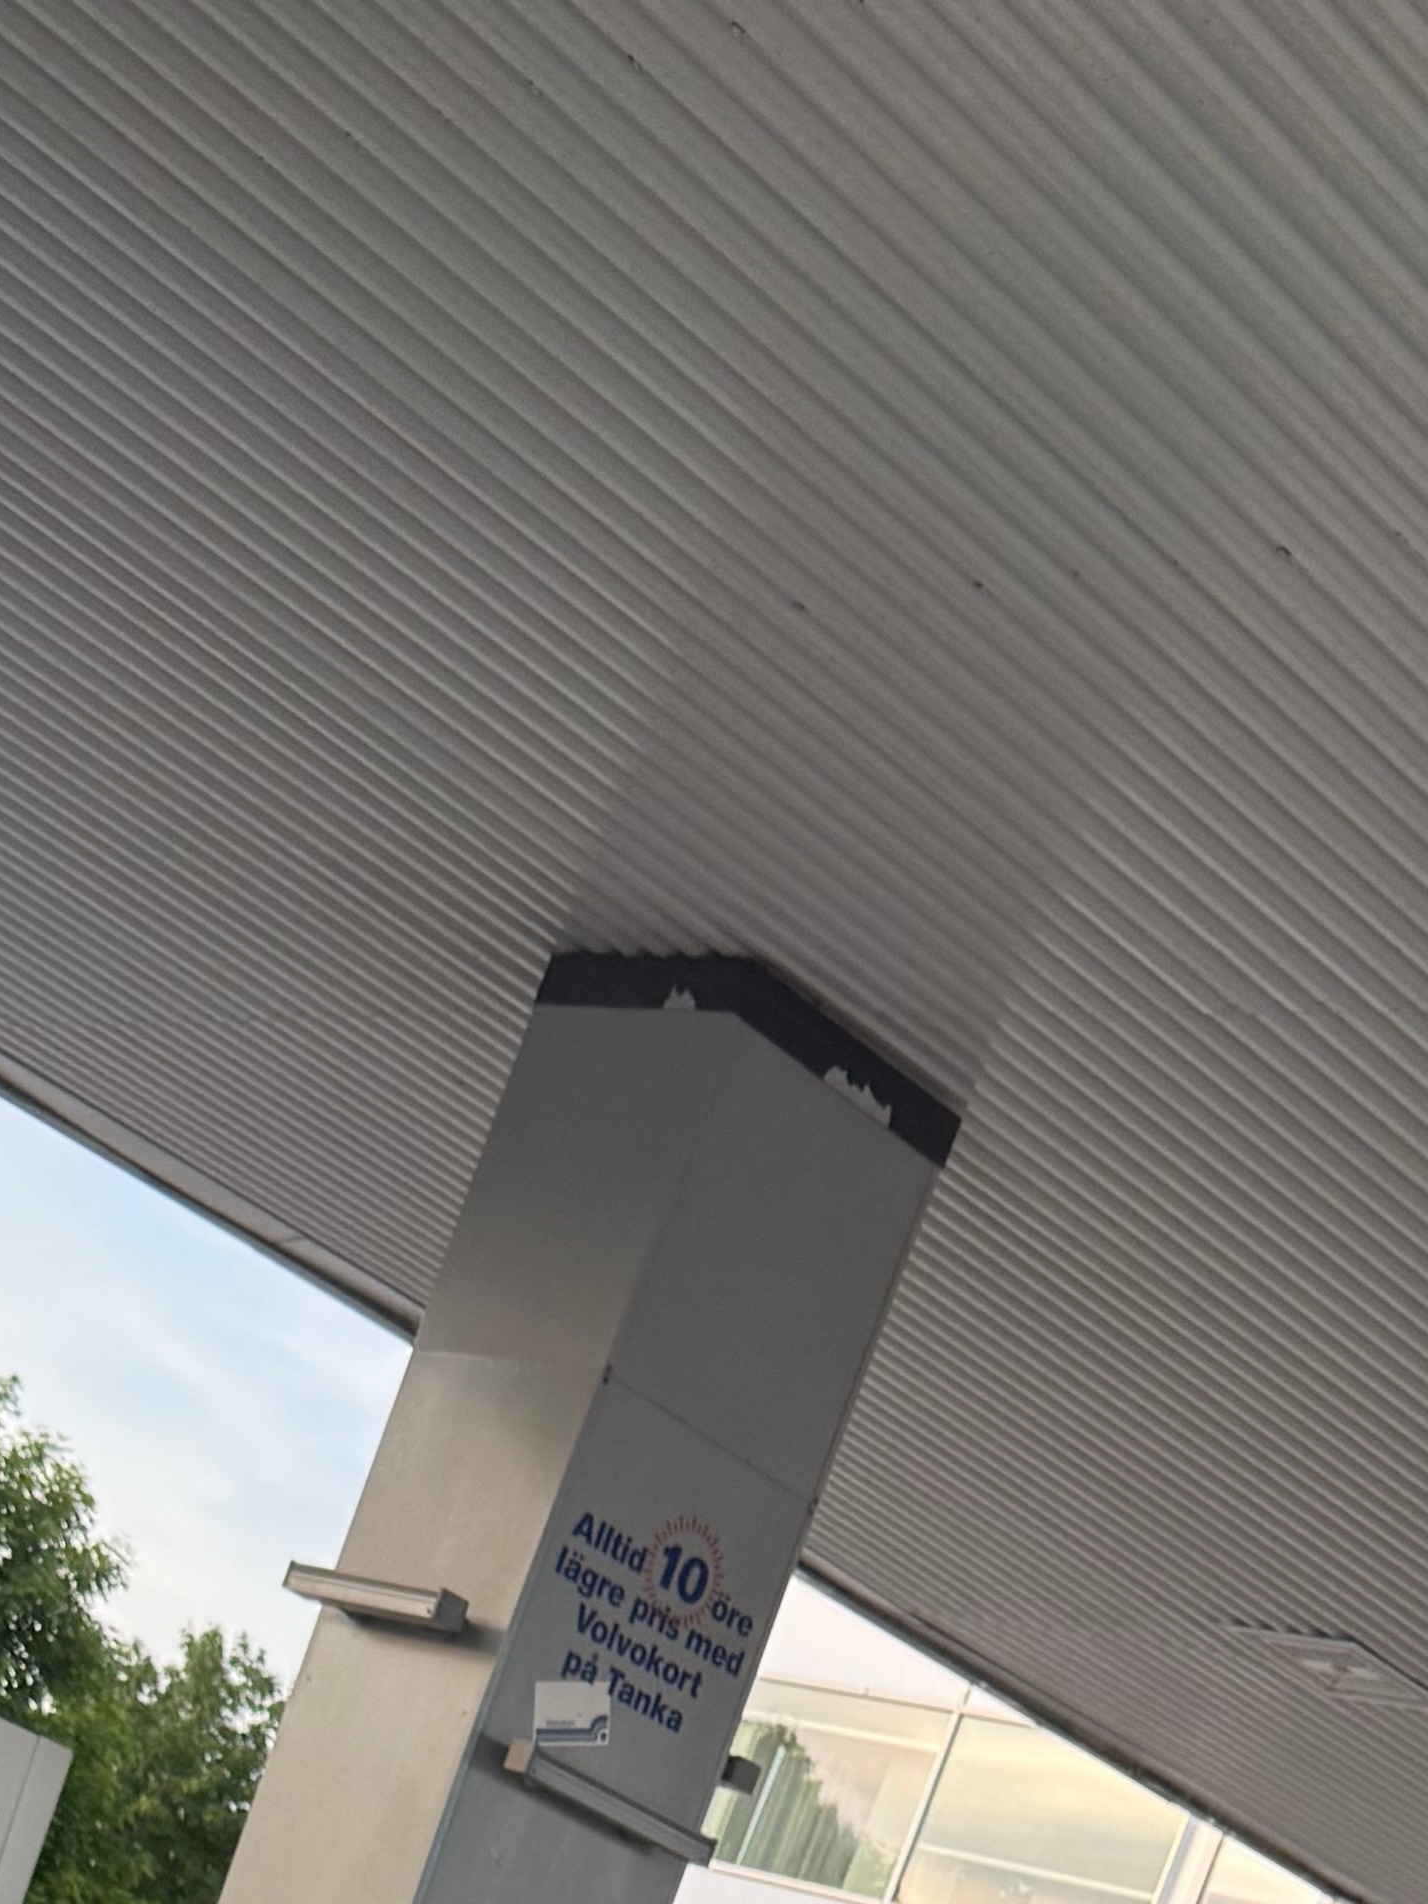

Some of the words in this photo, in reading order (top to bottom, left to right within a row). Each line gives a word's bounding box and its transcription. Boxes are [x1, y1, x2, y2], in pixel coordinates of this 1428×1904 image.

[554, 1547, 626, 1607] lägre
[629, 1597, 679, 1641] pris
[687, 1629, 746, 1678] med
[572, 1512, 647, 1574] Alltid
[657, 1546, 709, 1605] 10
[711, 1594, 754, 1638] öre
[561, 1649, 599, 1685] på
[607, 1667, 684, 1734] Tanka
[576, 1603, 703, 1699] Volvokort
